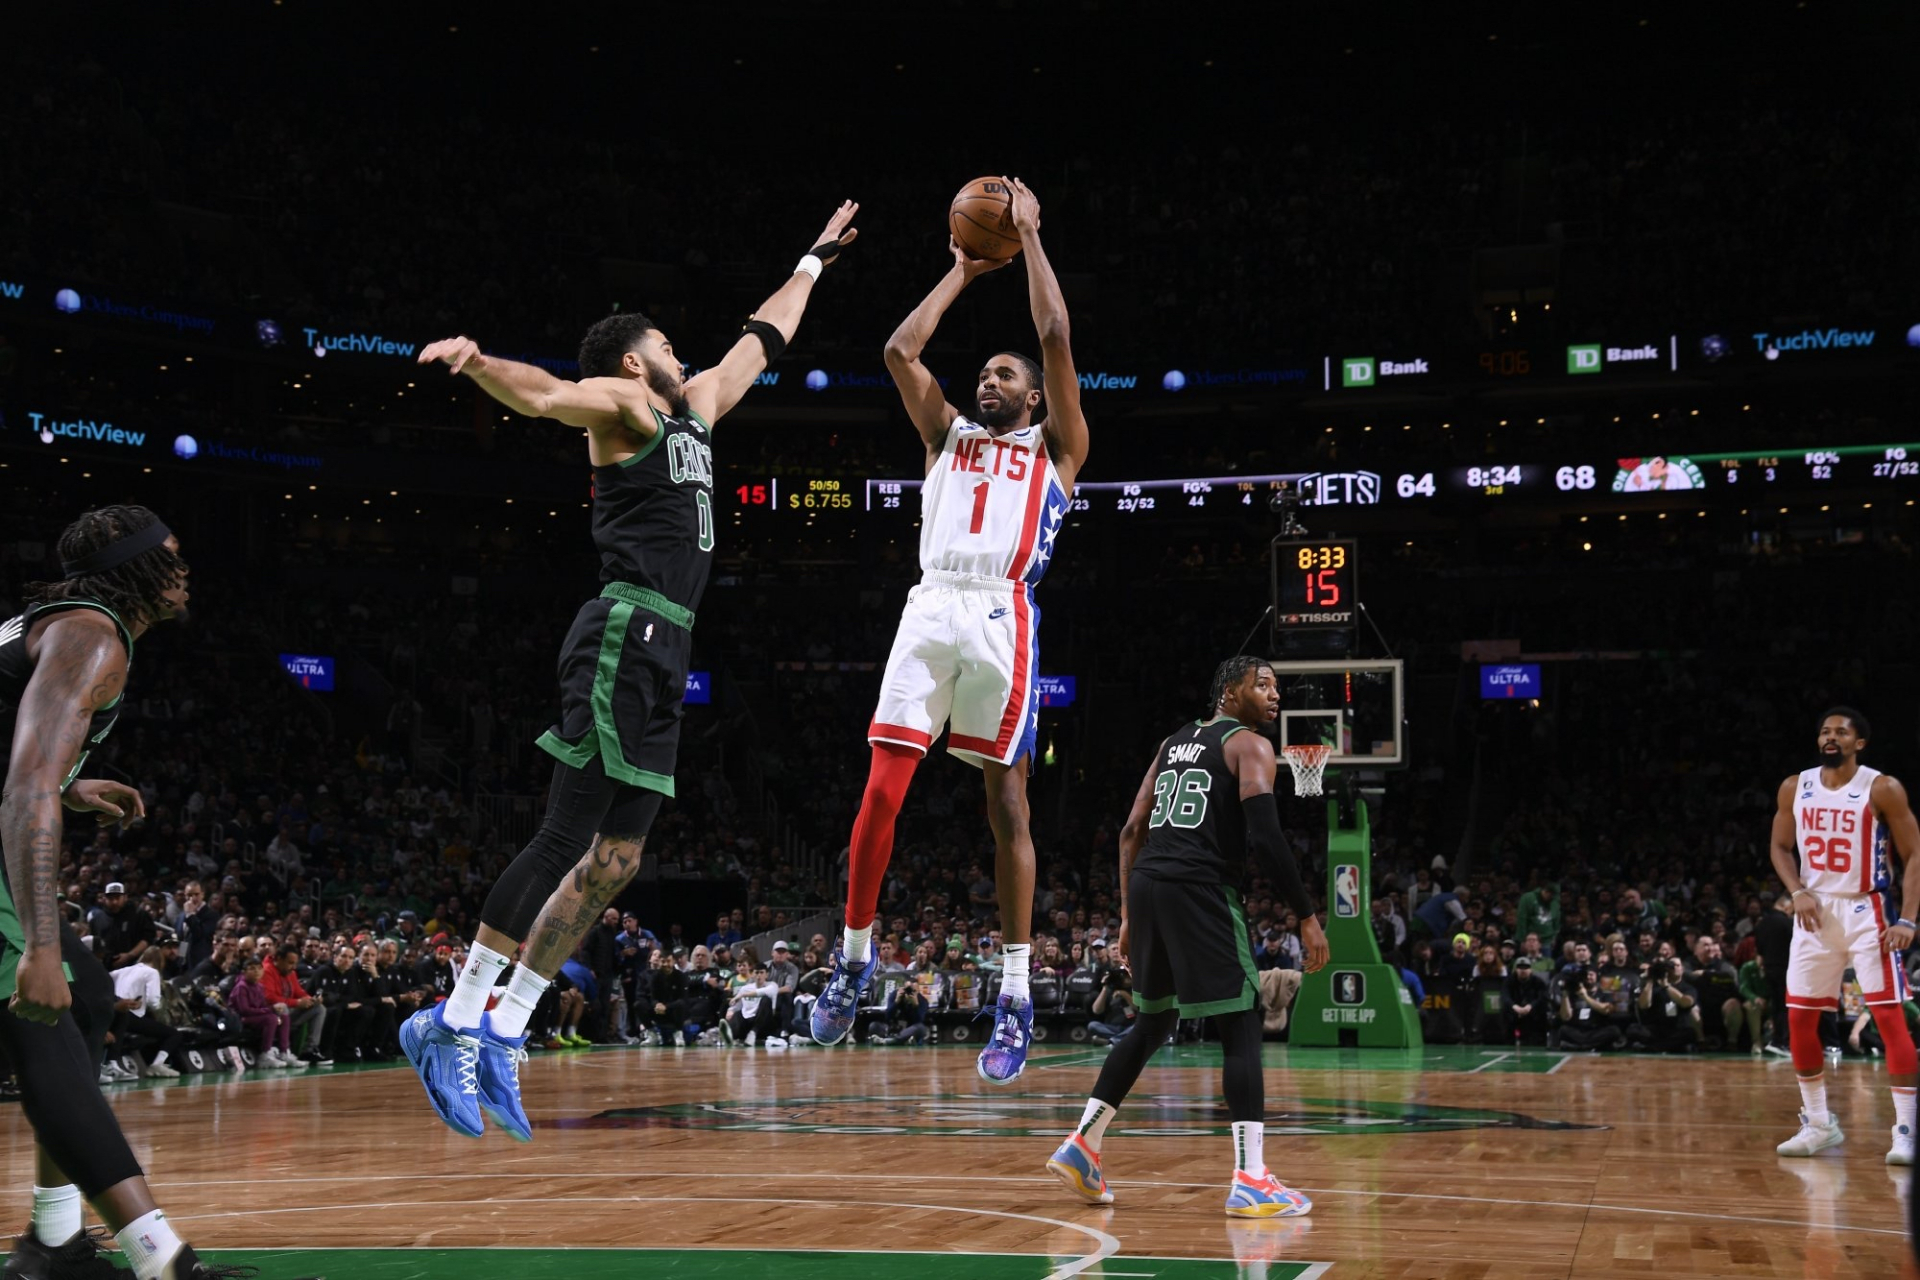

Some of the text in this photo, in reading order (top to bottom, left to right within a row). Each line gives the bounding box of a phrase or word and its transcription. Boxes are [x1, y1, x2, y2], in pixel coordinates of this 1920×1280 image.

[1570, 345, 1659, 369] TD Bank
[1345, 358, 1430, 383] TD Bank
[951, 438, 1030, 482] NETS
[1805, 451, 1840, 465] FG%
[1885, 447, 1906, 460] FG
[1466, 465, 1522, 487] 8:34
[1727, 470, 1738, 483] 5
[1765, 468, 1776, 481] 3
[1812, 465, 1831, 479] 52
[1873, 462, 1919, 479] 27/52
[1555, 465, 1596, 491] 68
[809, 480, 840, 491] 50/50
[878, 483, 902, 494] REB
[1123, 485, 1141, 496] FG
[1183, 482, 1212, 494] FG%
[1397, 473, 1436, 498] 64
[1485, 486, 1503, 495] 3rd
[736, 484, 767, 504] 15
[1242, 494, 1252, 505] 4
[883, 497, 900, 508] 25
[969, 481, 990, 534] 1
[1067, 499, 1090, 513] /23
[1117, 498, 1155, 513] 23/52
[1189, 496, 1204, 507] 44
[696, 489, 715, 552] 0
[1298, 546, 1345, 569] 8:33
[1306, 570, 1339, 606] 15
[1300, 611, 1351, 622] TISSOT
[287, 663, 325, 676] ULTRA
[1489, 673, 1530, 685] ULTRA
[1038, 684, 1067, 694] LTRA
[1167, 743, 1206, 765] SMART
[1149, 768, 1212, 830] 36
[1802, 807, 1856, 833] NETS
[1804, 836, 1852, 874] 26
[1321, 1008, 1377, 1024] GET THE APP
